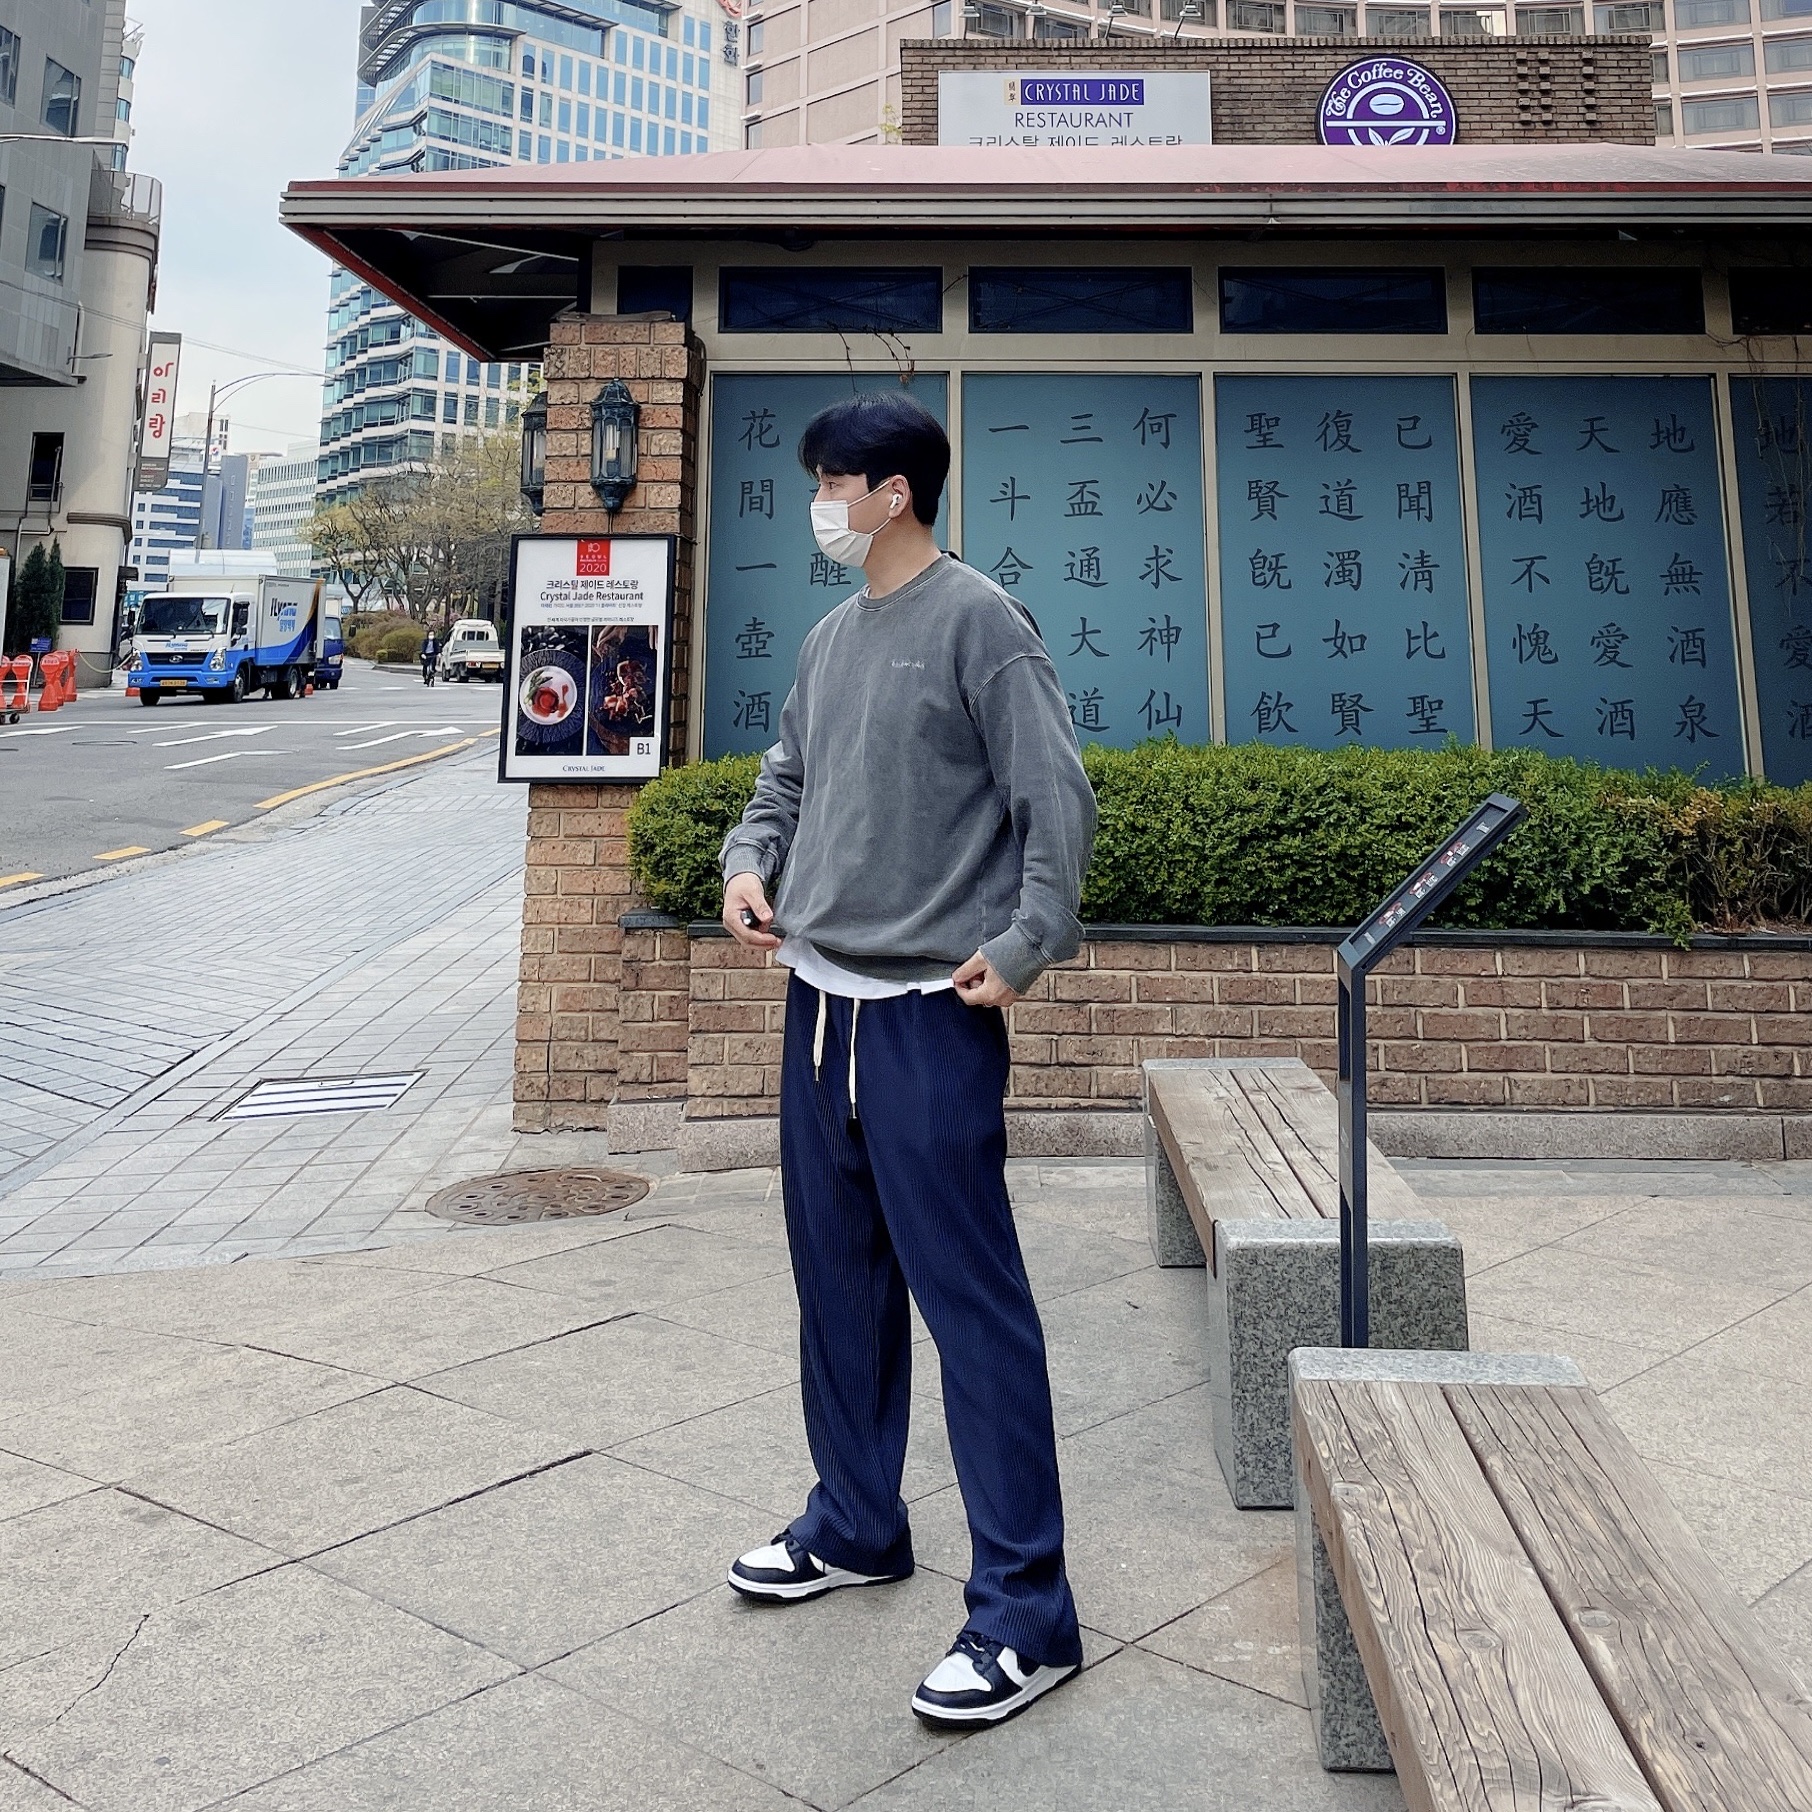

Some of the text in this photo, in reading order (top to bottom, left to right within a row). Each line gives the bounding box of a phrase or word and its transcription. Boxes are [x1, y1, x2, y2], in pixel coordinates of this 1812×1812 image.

[1024, 83, 1091, 101] CRYSTAL
[1099, 83, 1140, 101] JADE
[1326, 63, 1444, 118] The Coffee Bean
[1014, 112, 1134, 128] RESTAURANT
[579, 563, 607, 573] 2020
[1133, 407, 1183, 732] 何必求神仙
[1501, 411, 1565, 739] 愛酒不愧天
[546, 580, 639, 590] 크리스탈 제이드 레스토랑
[1649, 413, 1720, 744] 地應無酒泉
[540, 591, 644, 603] Crystal Jade Restaurant
[636, 742, 652, 755] B1
